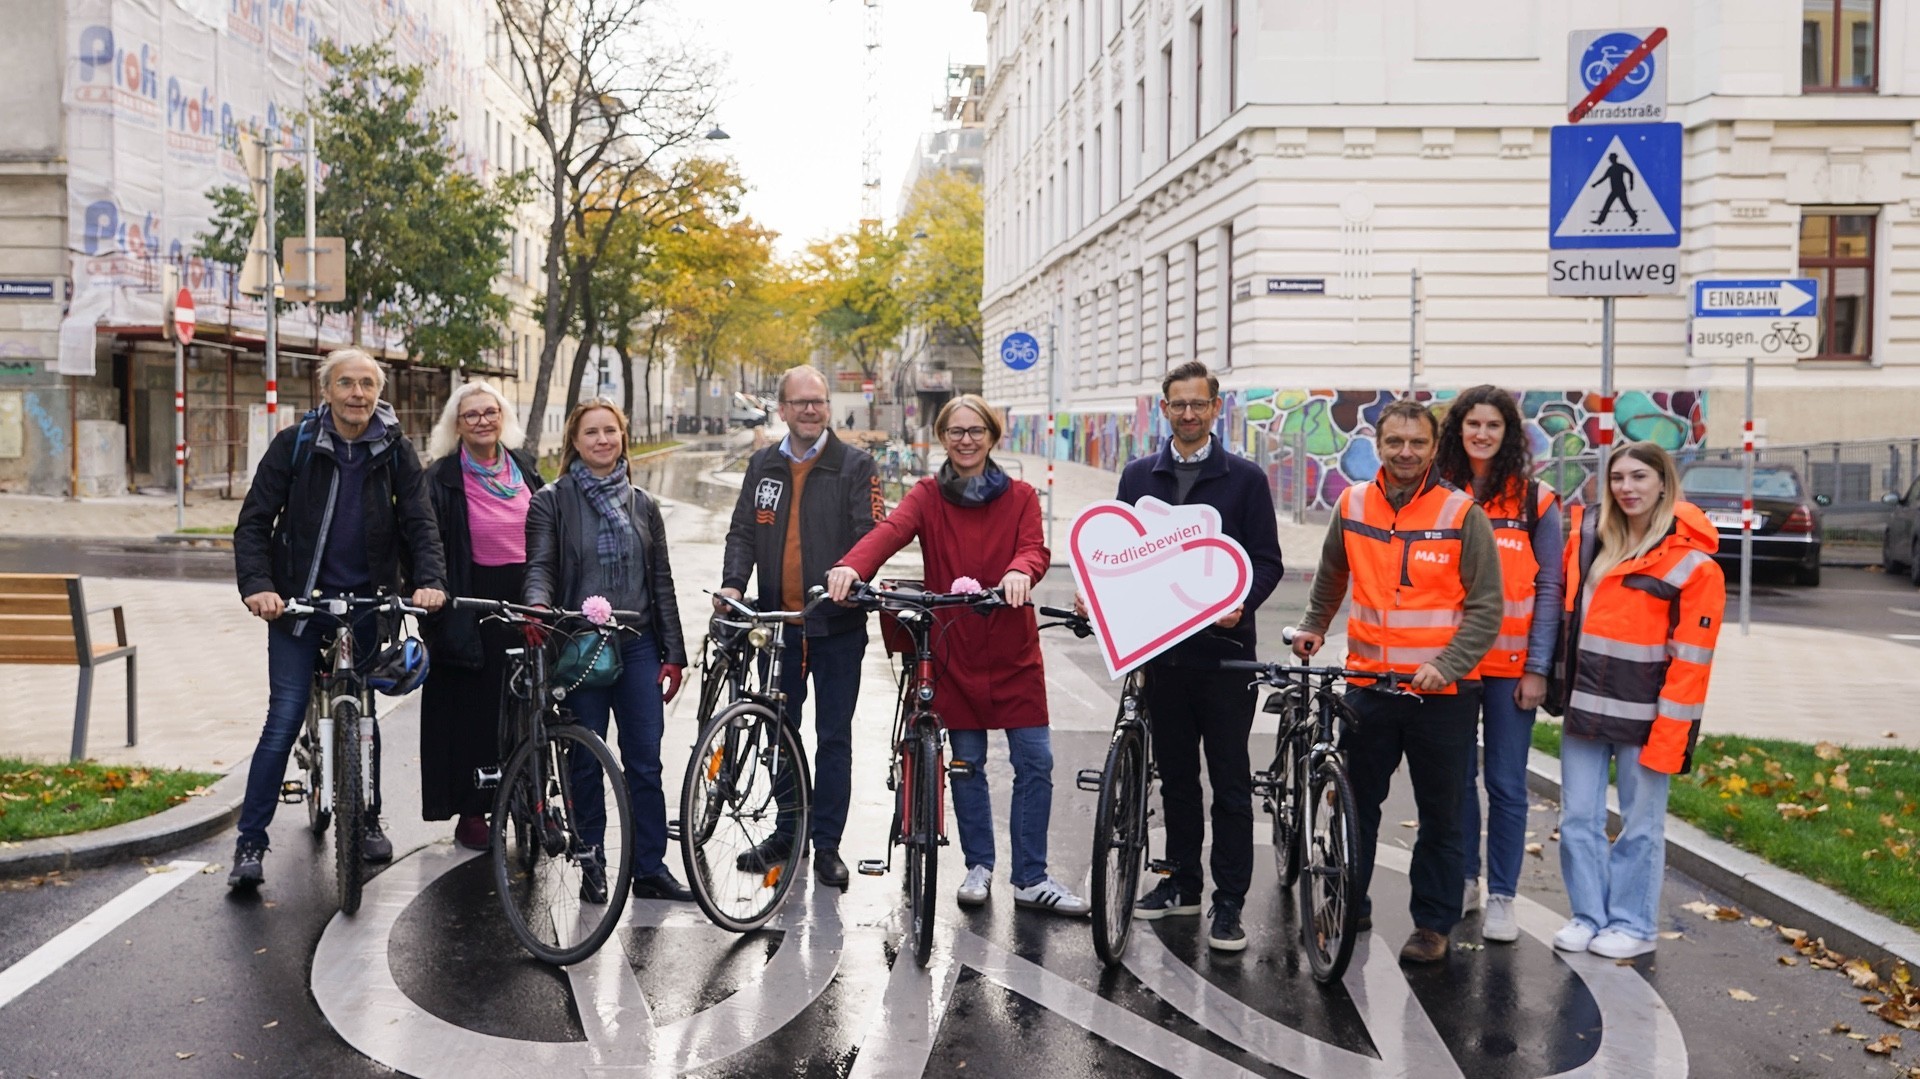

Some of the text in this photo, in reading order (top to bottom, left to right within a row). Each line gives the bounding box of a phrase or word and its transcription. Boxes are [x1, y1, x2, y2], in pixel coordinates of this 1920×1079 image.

[1553, 260, 1676, 285] Schulweg
[1709, 291, 1779, 306] EINBAHN
[1697, 331, 1760, 348] ausgen.
[1091, 524, 1202, 564] #radliebewien
[1414, 550, 1436, 563] MA
